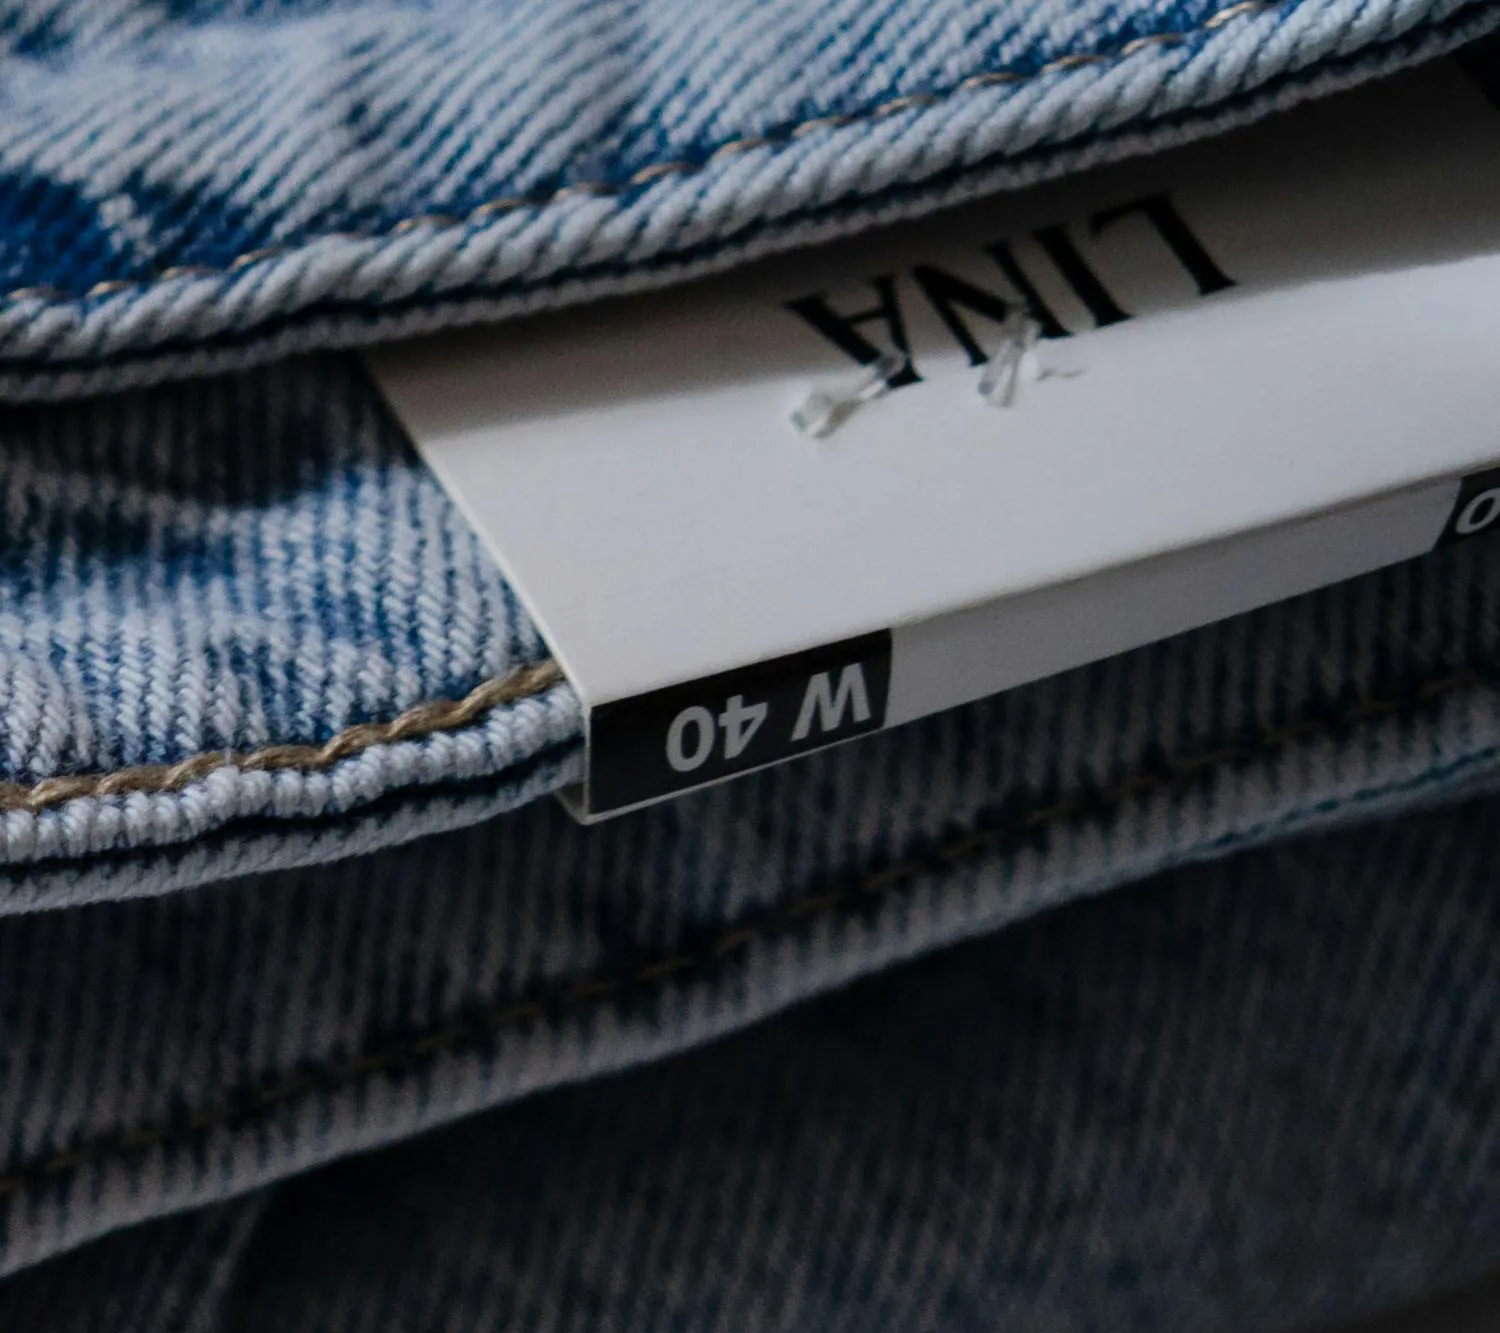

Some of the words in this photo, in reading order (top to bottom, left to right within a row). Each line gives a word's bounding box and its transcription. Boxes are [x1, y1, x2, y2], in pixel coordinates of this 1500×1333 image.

[785, 193, 1238, 389] LINA
[666, 694, 768, 773] 40
[790, 662, 872, 742] W
